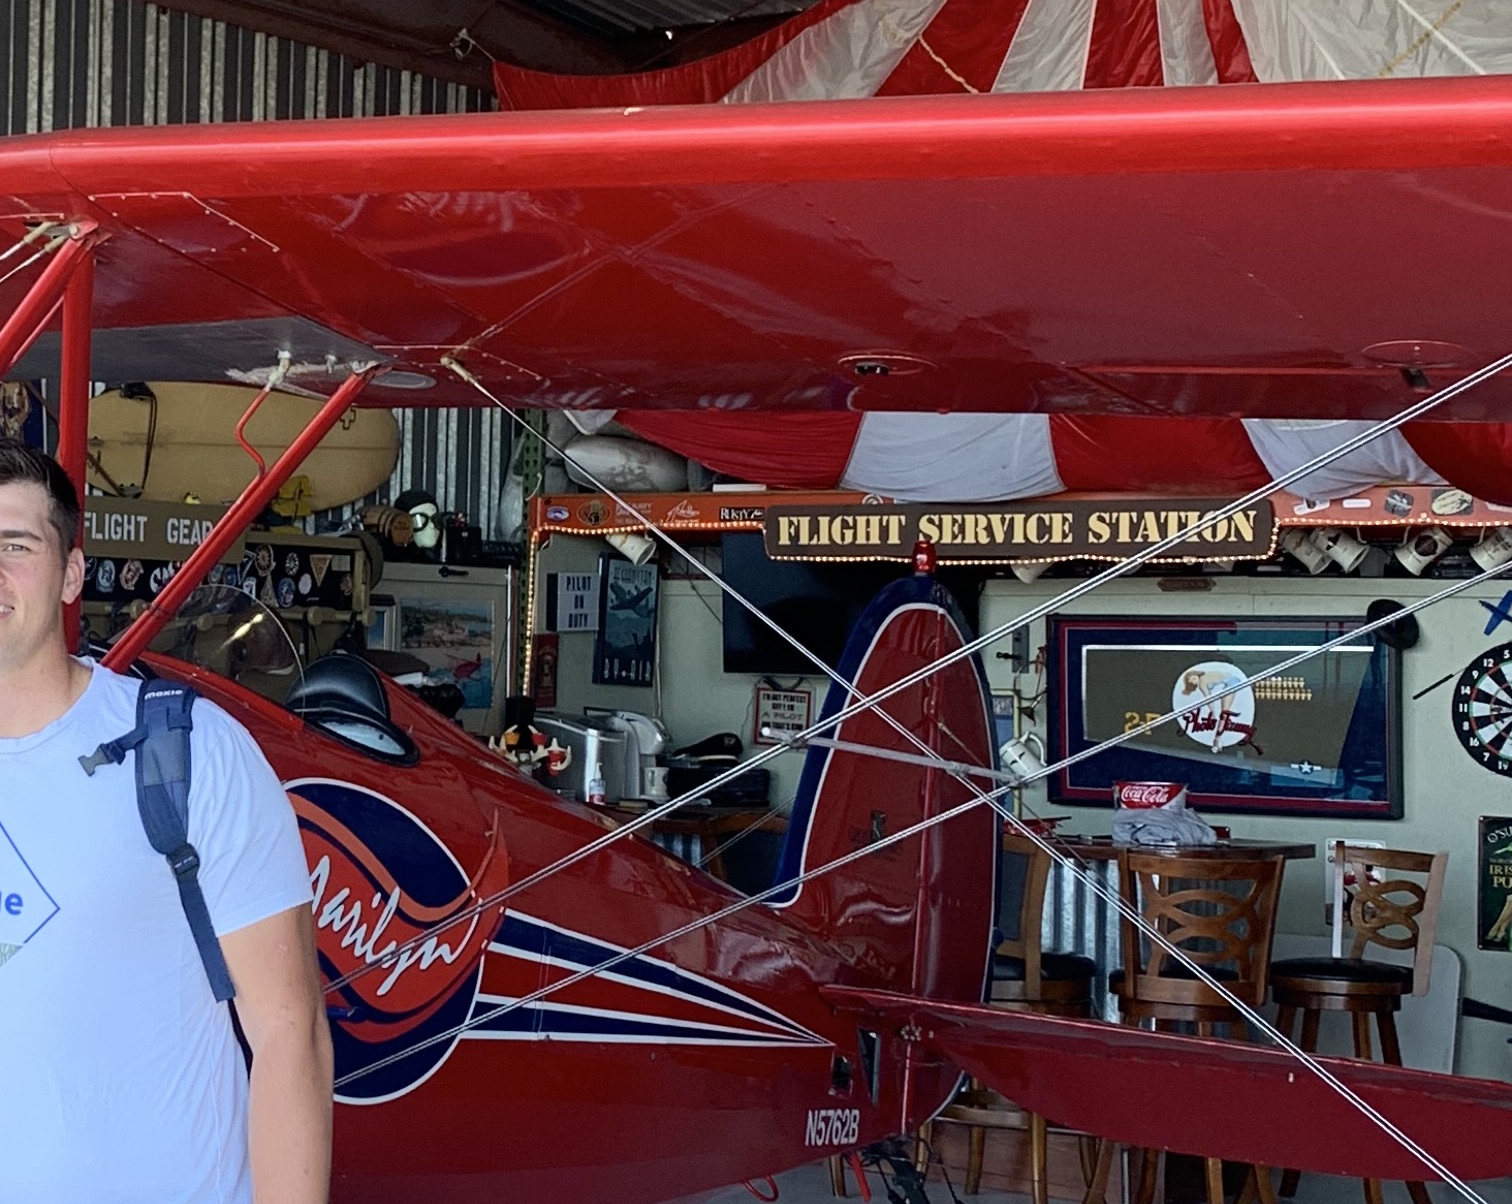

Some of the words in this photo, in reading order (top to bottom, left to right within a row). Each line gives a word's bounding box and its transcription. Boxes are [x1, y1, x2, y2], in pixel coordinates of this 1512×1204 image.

[778, 515, 906, 545] FLIGHT
[918, 513, 1073, 545] SERVICE
[1088, 511, 1257, 543] STATION
[566, 576, 591, 591] PILOT
[568, 613, 588, 628] DUTY
[1503, 649, 1511, 659] 5
[1483, 658, 1494, 668] 12
[1471, 670, 1479, 680] 9
[144, 689, 184, 700] moxie
[1460, 685, 1471, 695] 14
[1458, 703, 1469, 713] 11
[773, 712, 804, 721] PILOT
[1462, 721, 1470, 731] 8
[1469, 736, 1480, 747] 16
[1483, 752, 1490, 762] 7
[805, 1108, 861, 1147] N5762B
